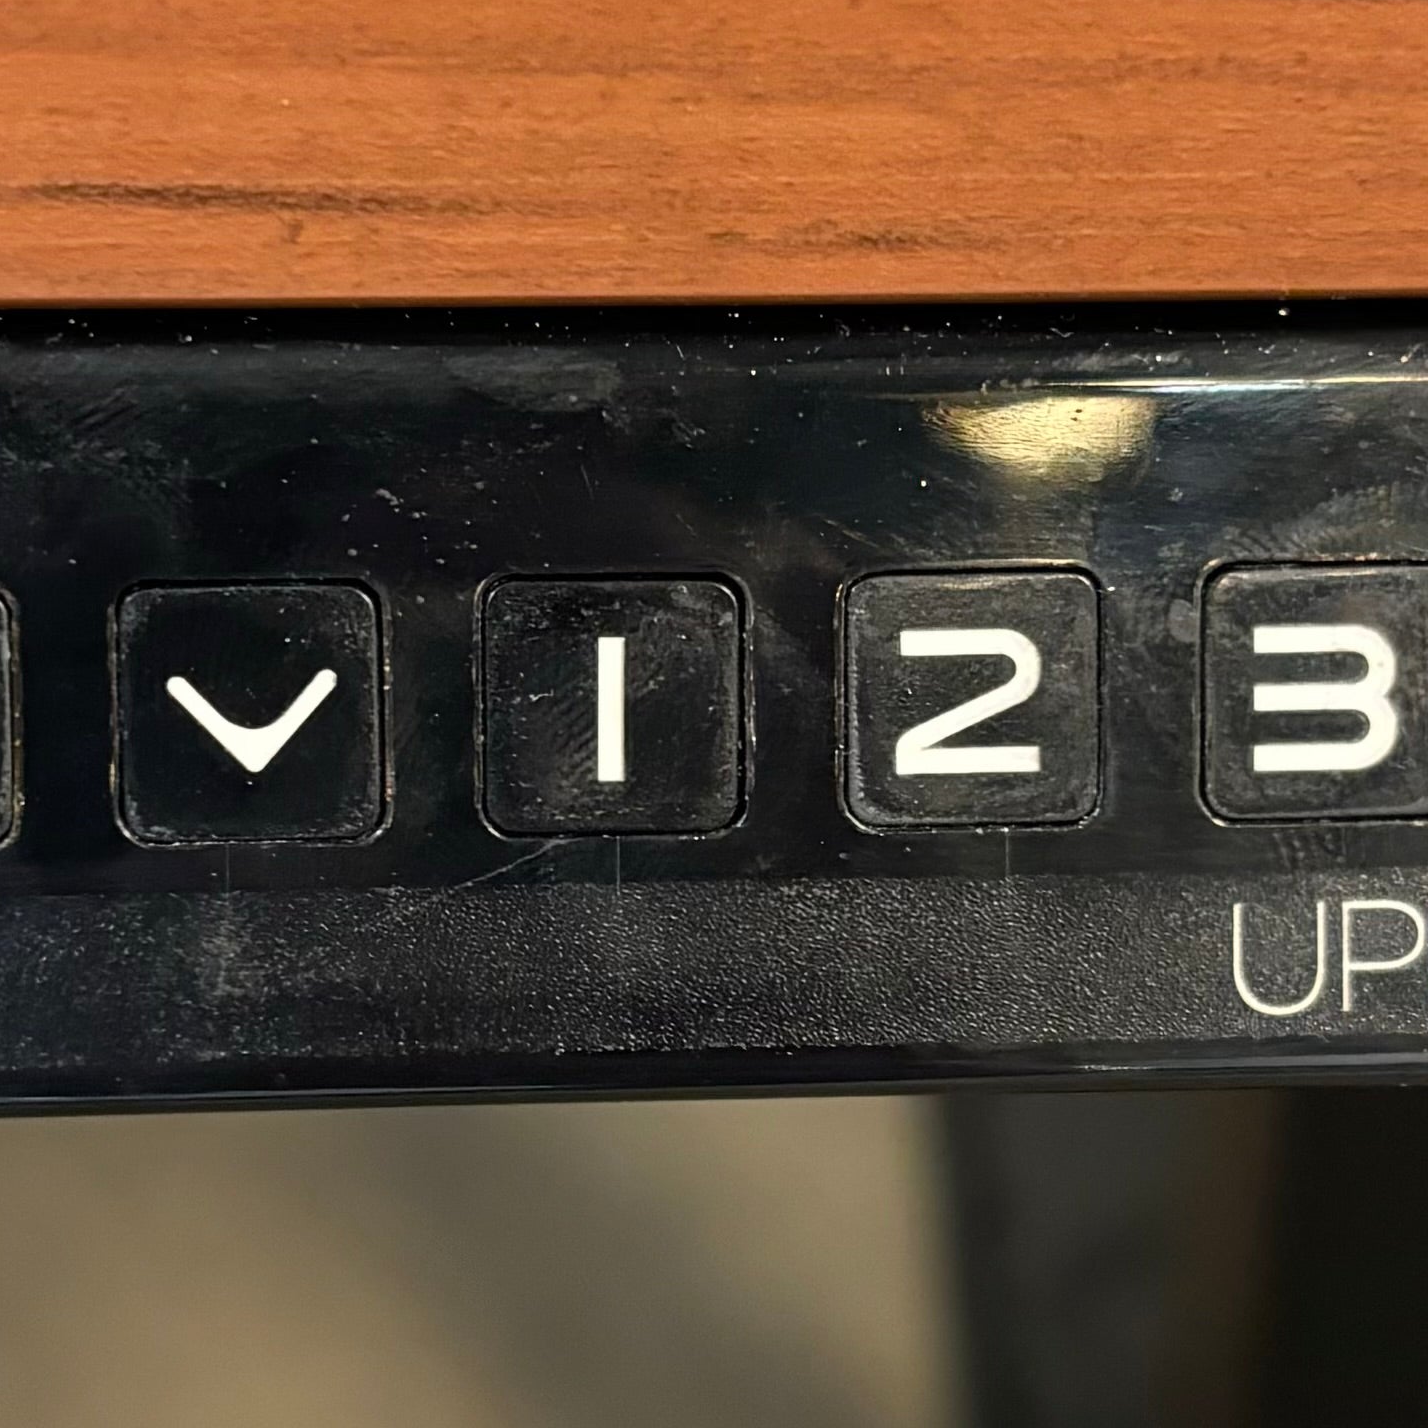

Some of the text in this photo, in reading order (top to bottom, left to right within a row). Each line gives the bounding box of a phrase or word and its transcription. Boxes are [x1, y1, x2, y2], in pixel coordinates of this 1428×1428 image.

[596, 635, 627, 783] 1
[894, 627, 1042, 777] 2
[1252, 622, 1400, 773] 3
